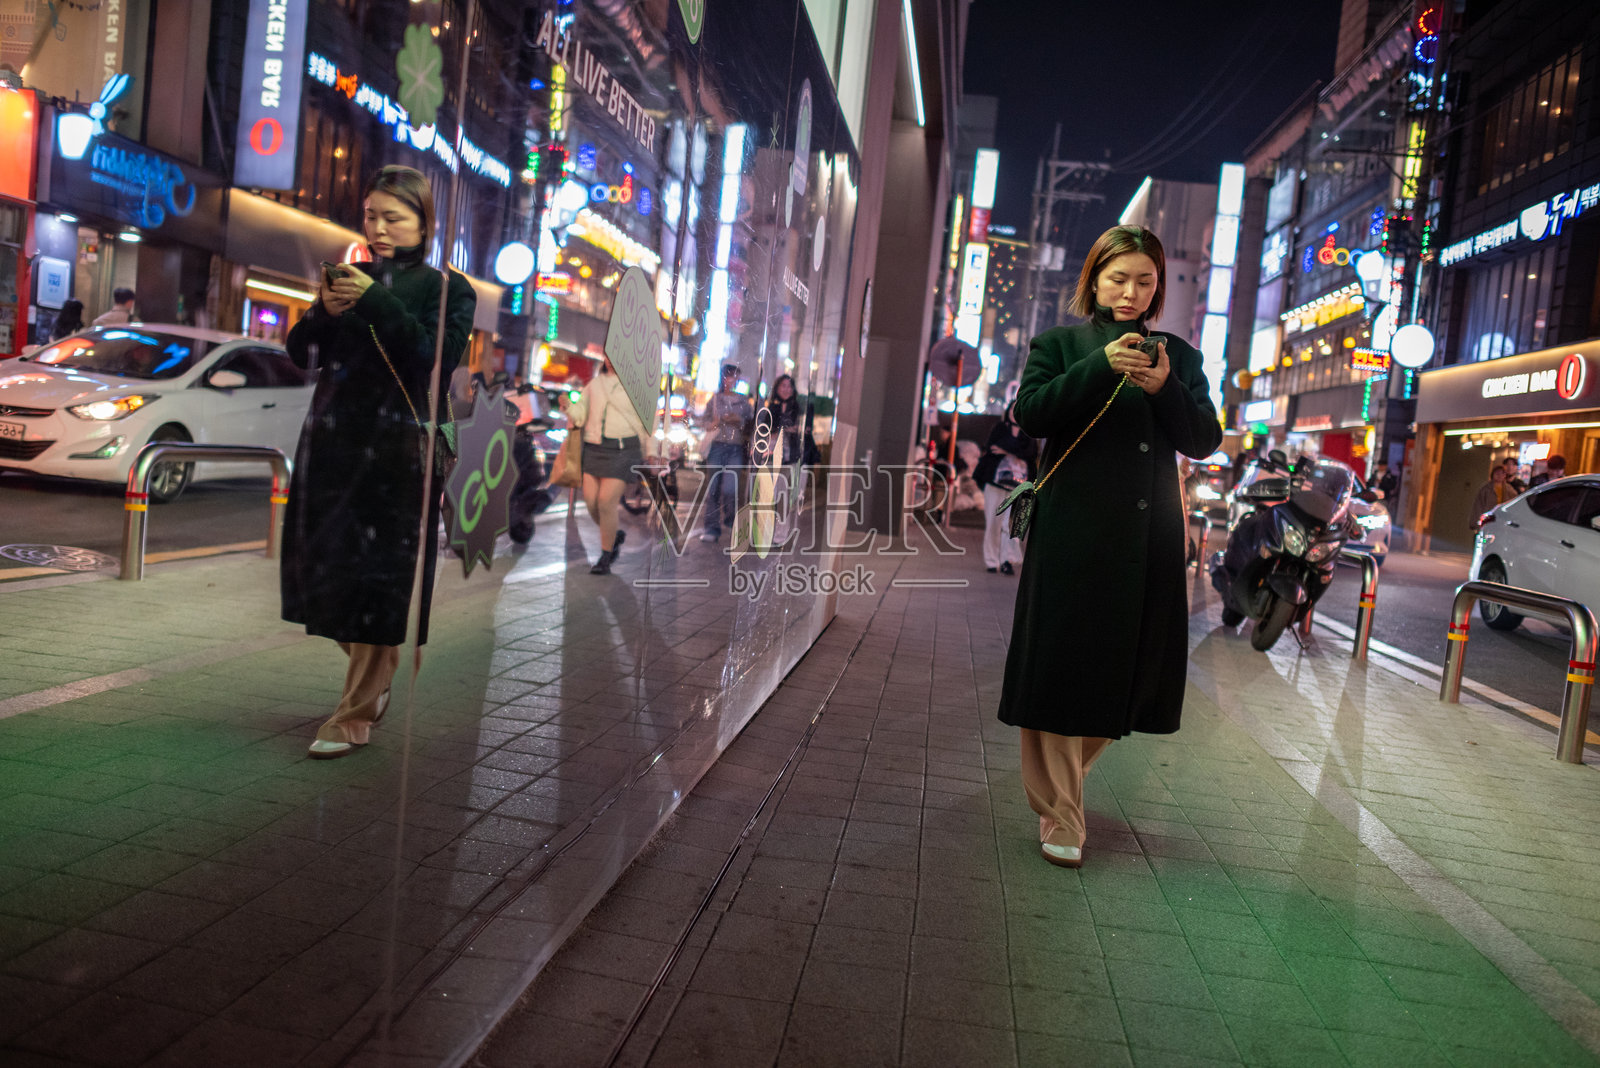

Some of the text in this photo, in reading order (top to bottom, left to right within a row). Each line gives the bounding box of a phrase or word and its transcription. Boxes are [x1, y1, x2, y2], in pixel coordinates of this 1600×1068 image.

[536, 10, 572, 73] ALL
[573, 40, 609, 107] LIVE
[607, 78, 656, 154] BETTER
[612, 334, 652, 421] PLAYGROUND
[1529, 369, 1558, 392] BAR
[459, 429, 509, 533] GO
